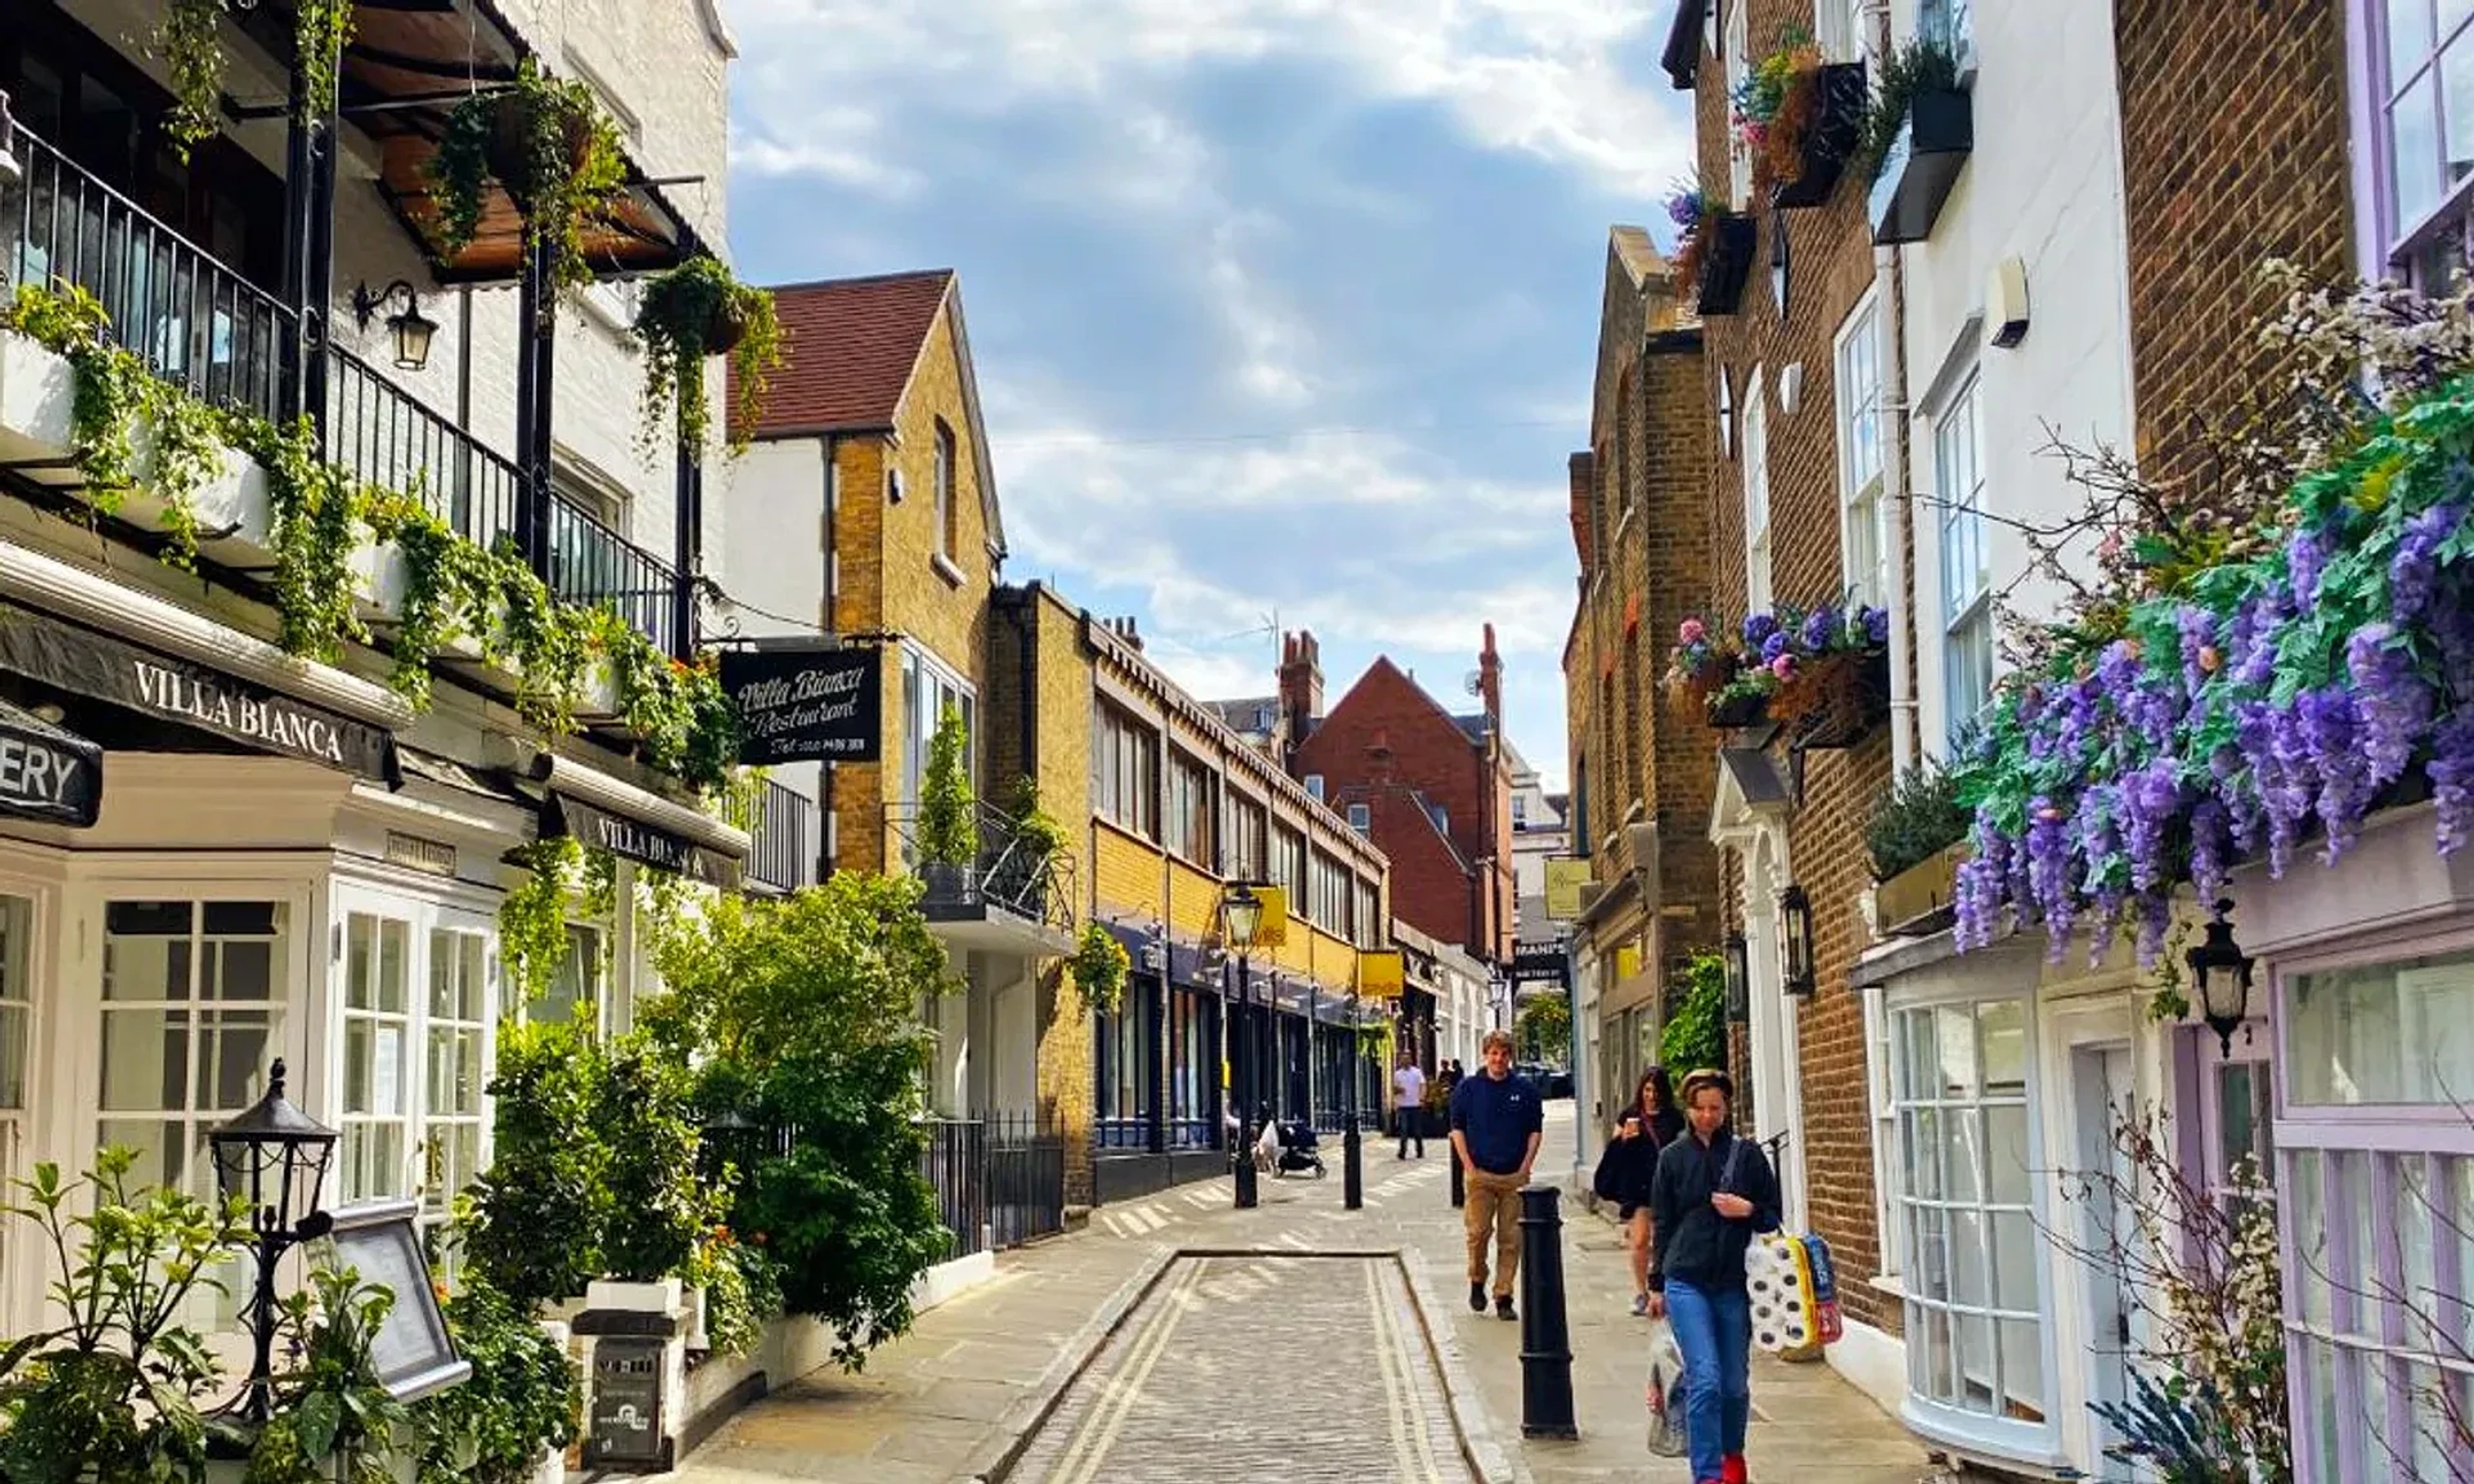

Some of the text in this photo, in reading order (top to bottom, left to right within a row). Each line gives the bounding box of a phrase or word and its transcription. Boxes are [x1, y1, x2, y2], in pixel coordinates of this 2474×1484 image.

[134, 661, 343, 762] VILLA BIANCA
[738, 666, 865, 712] Villa Bianca
[743, 692, 858, 738] Restaurant
[599, 817, 647, 857] VILLA
